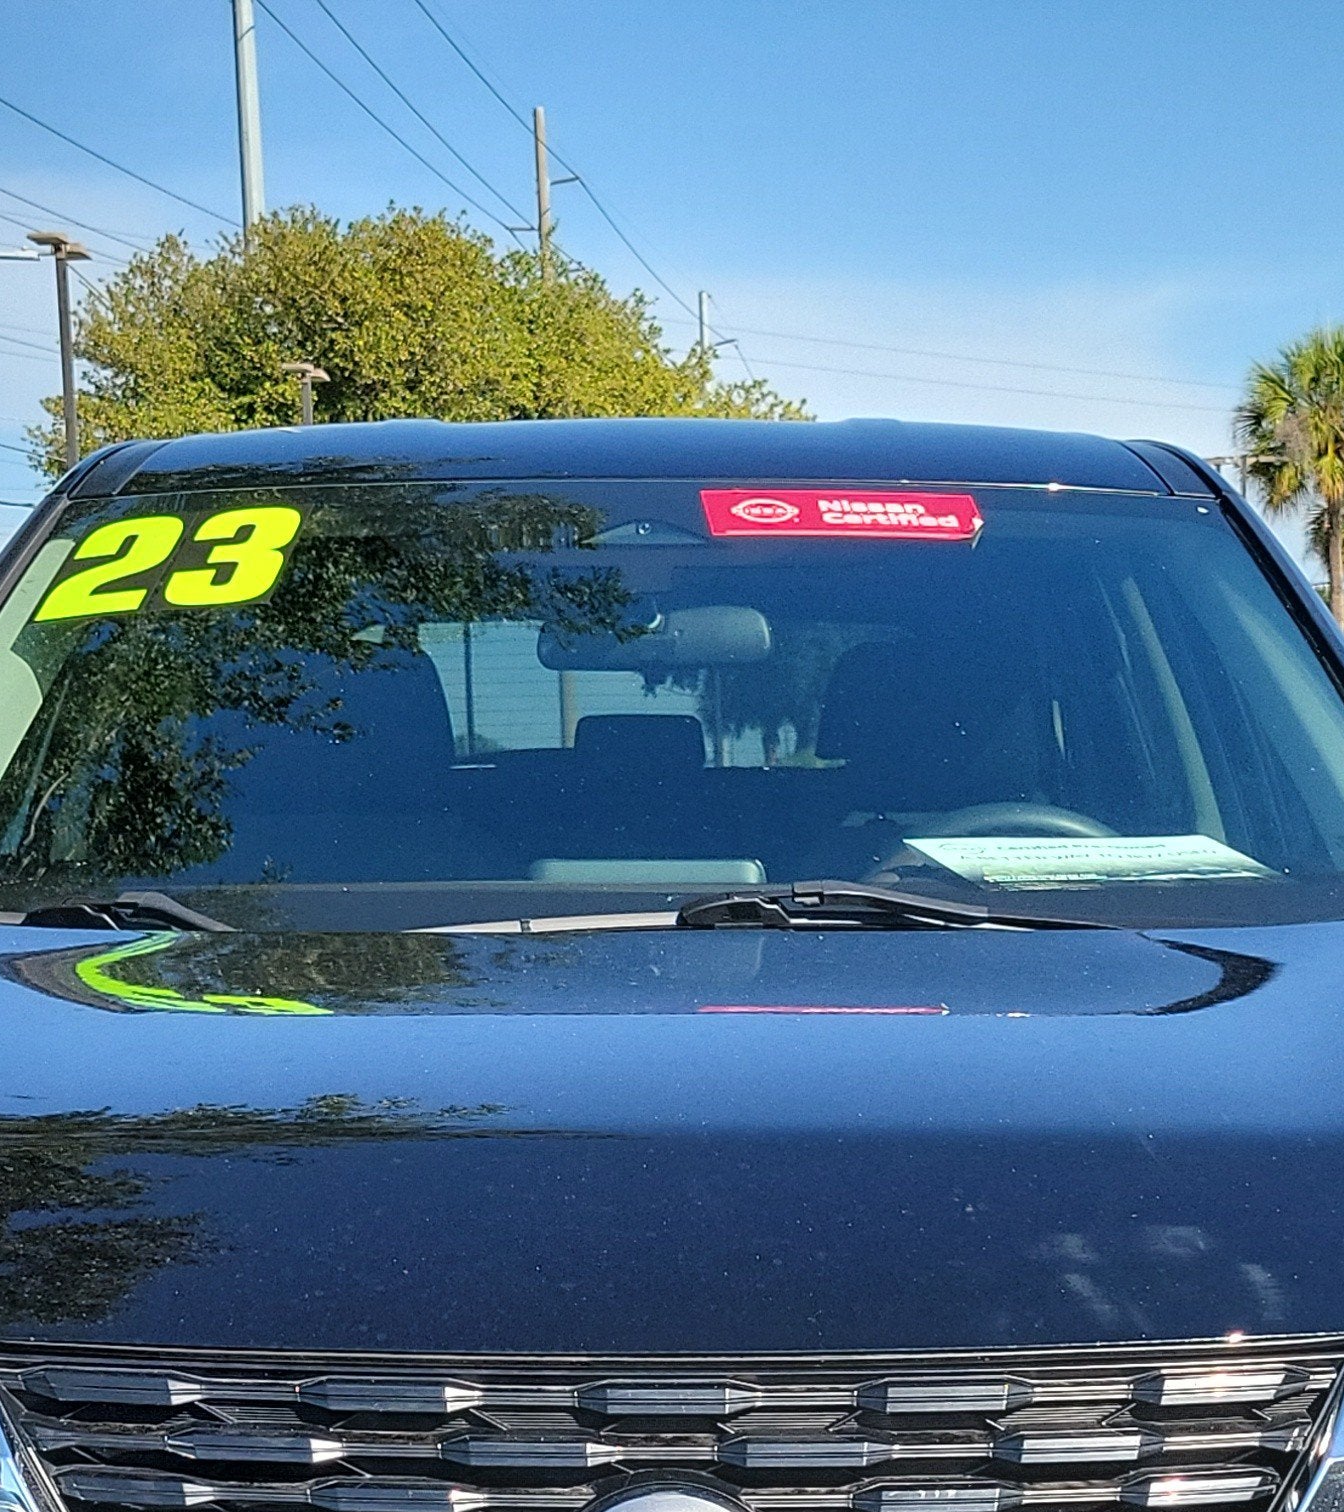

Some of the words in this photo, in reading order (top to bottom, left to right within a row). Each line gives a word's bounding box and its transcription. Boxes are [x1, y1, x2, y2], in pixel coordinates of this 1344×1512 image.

[818, 500, 925, 514] Nissan
[822, 512, 959, 528] Certified
[33, 507, 301, 622] 23
